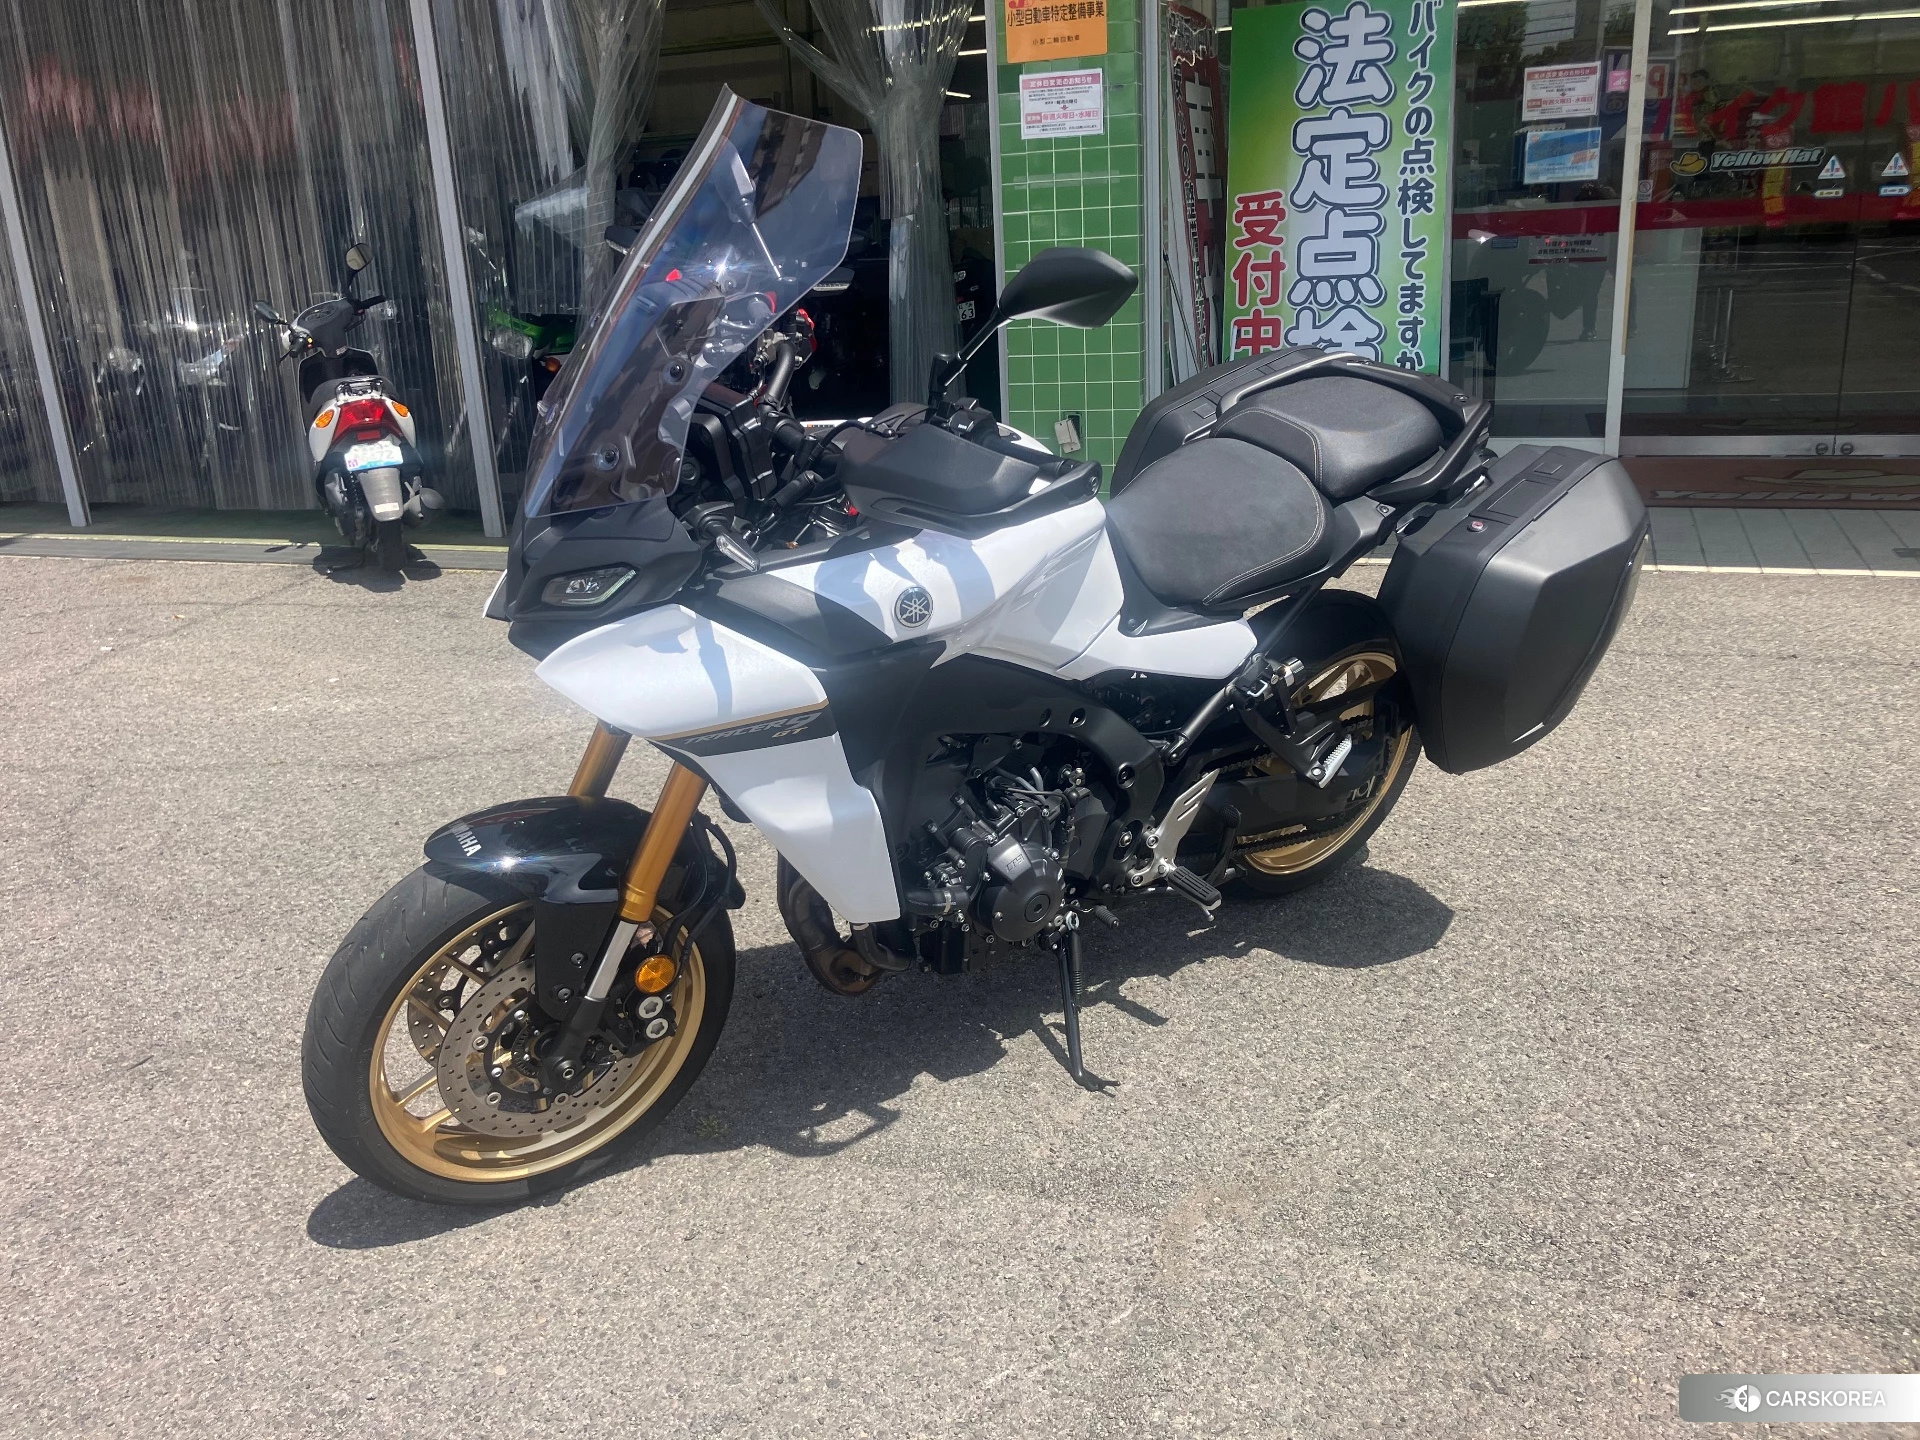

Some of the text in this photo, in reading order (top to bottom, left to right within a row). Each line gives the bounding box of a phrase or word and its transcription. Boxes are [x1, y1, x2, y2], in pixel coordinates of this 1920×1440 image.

[1007, 1, 1105, 27] 小型自動車特定整備事業
[1398, 1, 1442, 372] バイクの点検してますか
[1713, 150, 1820, 170] YellowHat
[1233, 191, 1286, 355] 受付中
